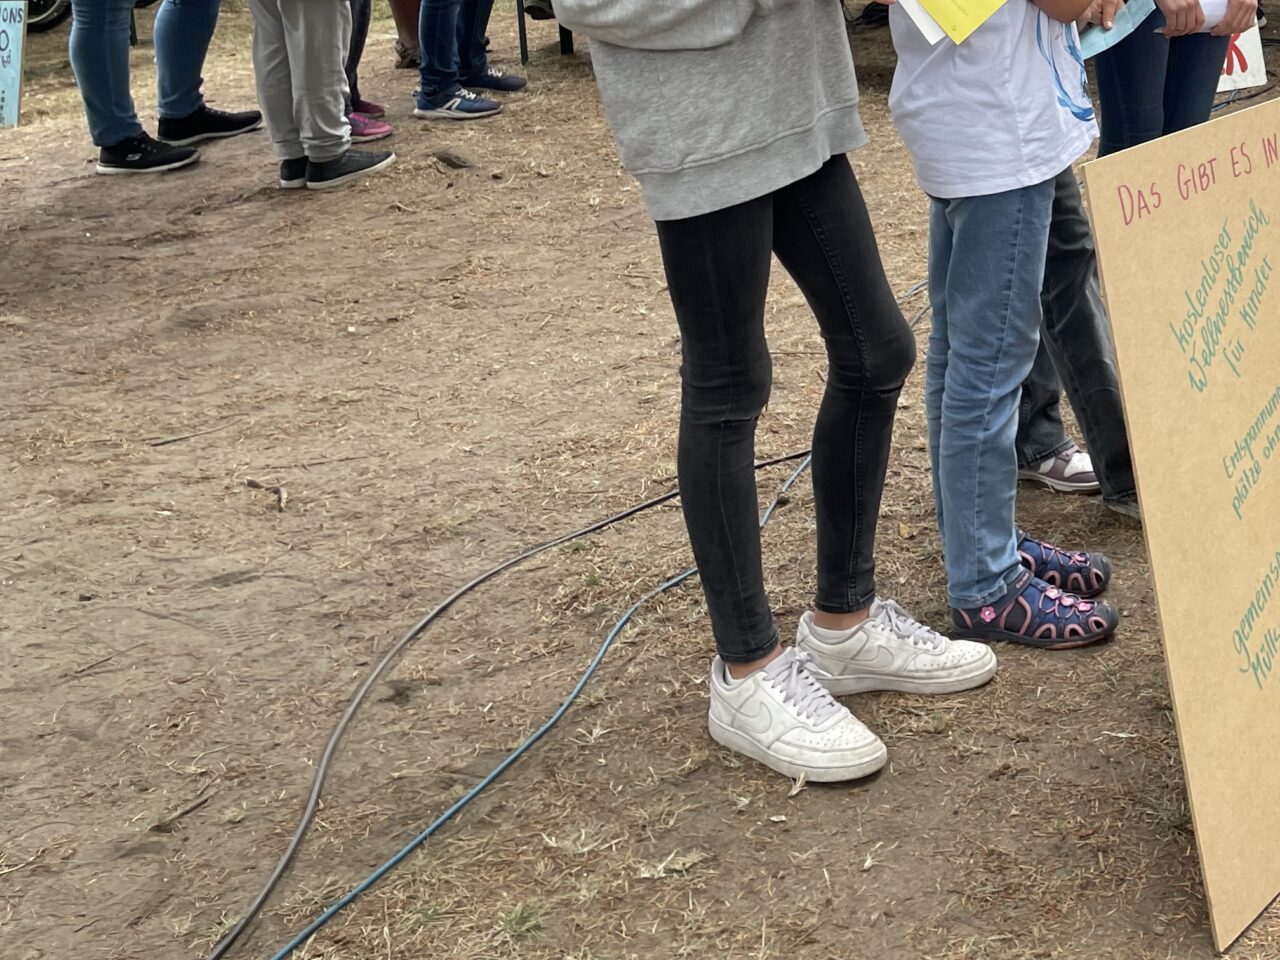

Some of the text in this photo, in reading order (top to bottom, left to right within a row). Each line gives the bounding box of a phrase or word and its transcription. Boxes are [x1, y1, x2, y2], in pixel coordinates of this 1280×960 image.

[1117, 182, 1162, 226] DAS
[1176, 156, 1218, 202] GIBT
[1230, 141, 1253, 179] ES
[1261, 132, 1280, 169] IN
[1222, 335, 1246, 379] für
[1231, 458, 1263, 521] plätze
